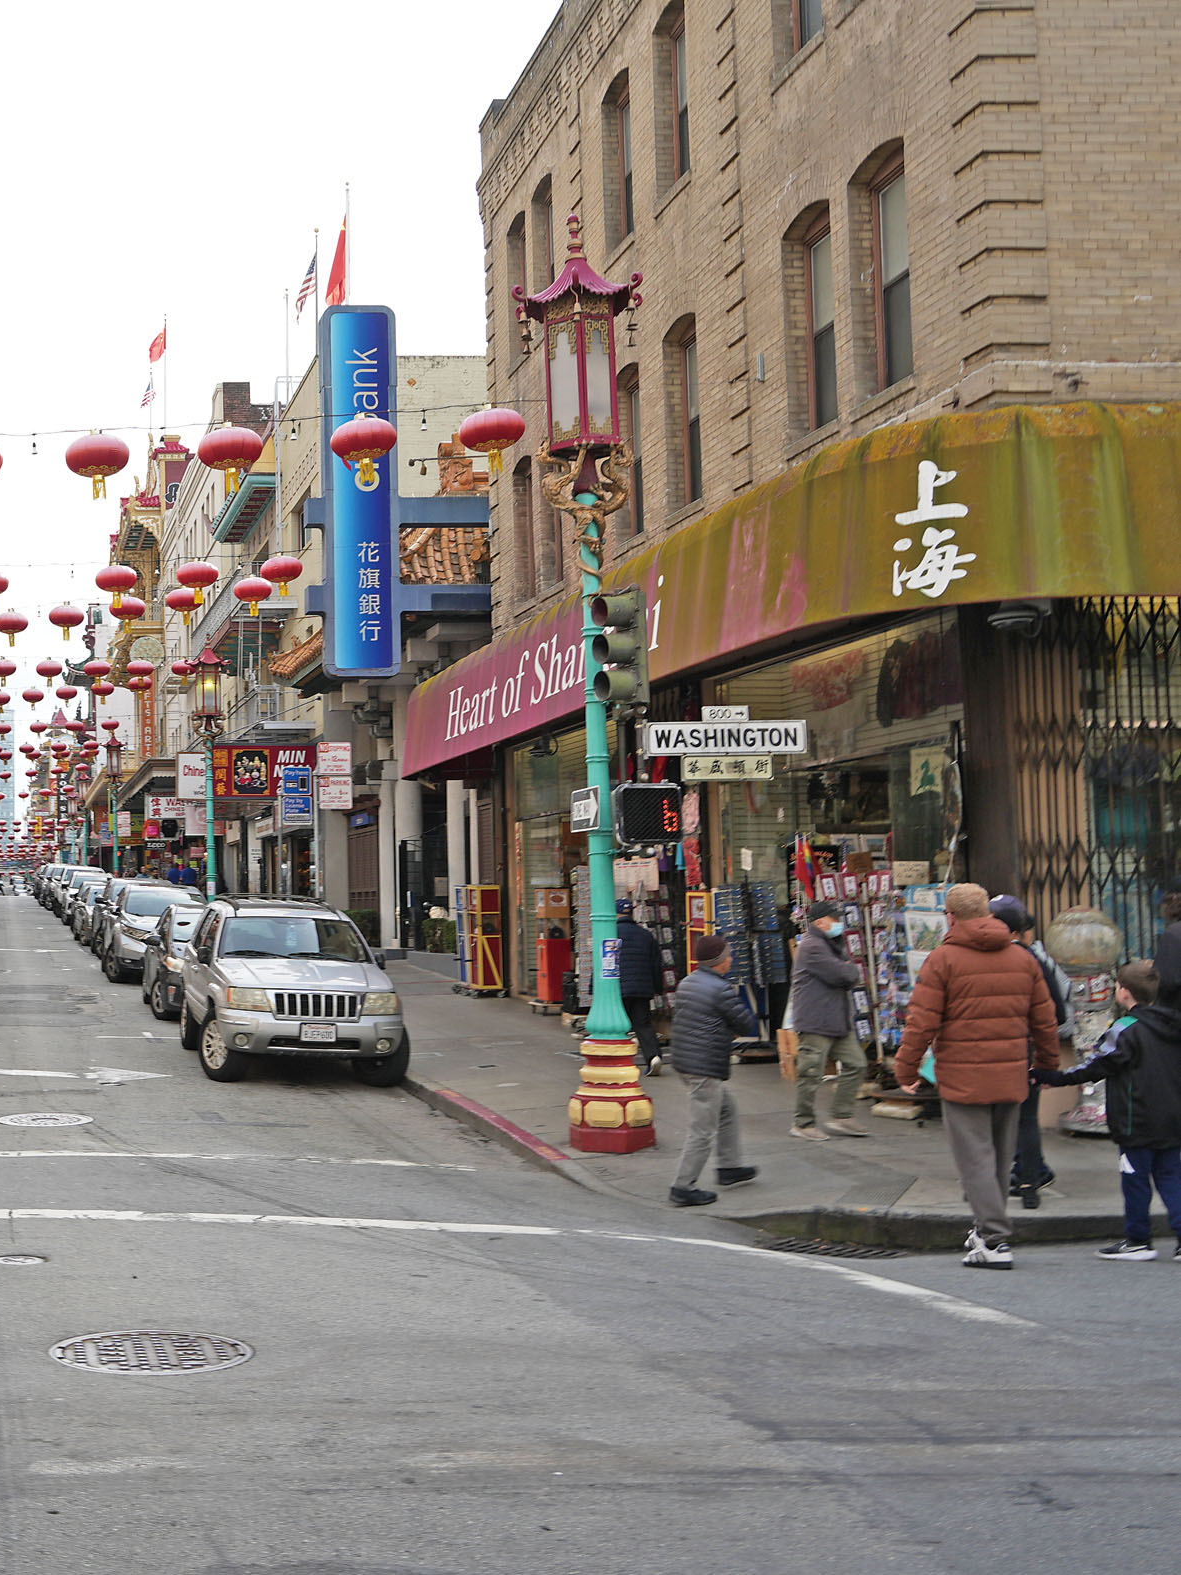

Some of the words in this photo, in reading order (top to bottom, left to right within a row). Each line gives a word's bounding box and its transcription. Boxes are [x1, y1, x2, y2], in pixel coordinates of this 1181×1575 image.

[345, 347, 380, 491] cank
[892, 460, 977, 598] 上海
[357, 541, 381, 642] 花旗銀行
[444, 675, 498, 741] Heart
[501, 650, 530, 719] of
[530, 574, 665, 707] Shai
[709, 709, 732, 719] 800
[144, 726, 152, 759] ARTS
[655, 727, 798, 749] WASHINGTON
[276, 750, 307, 764] MIN
[662, 799, 679, 832] 6
